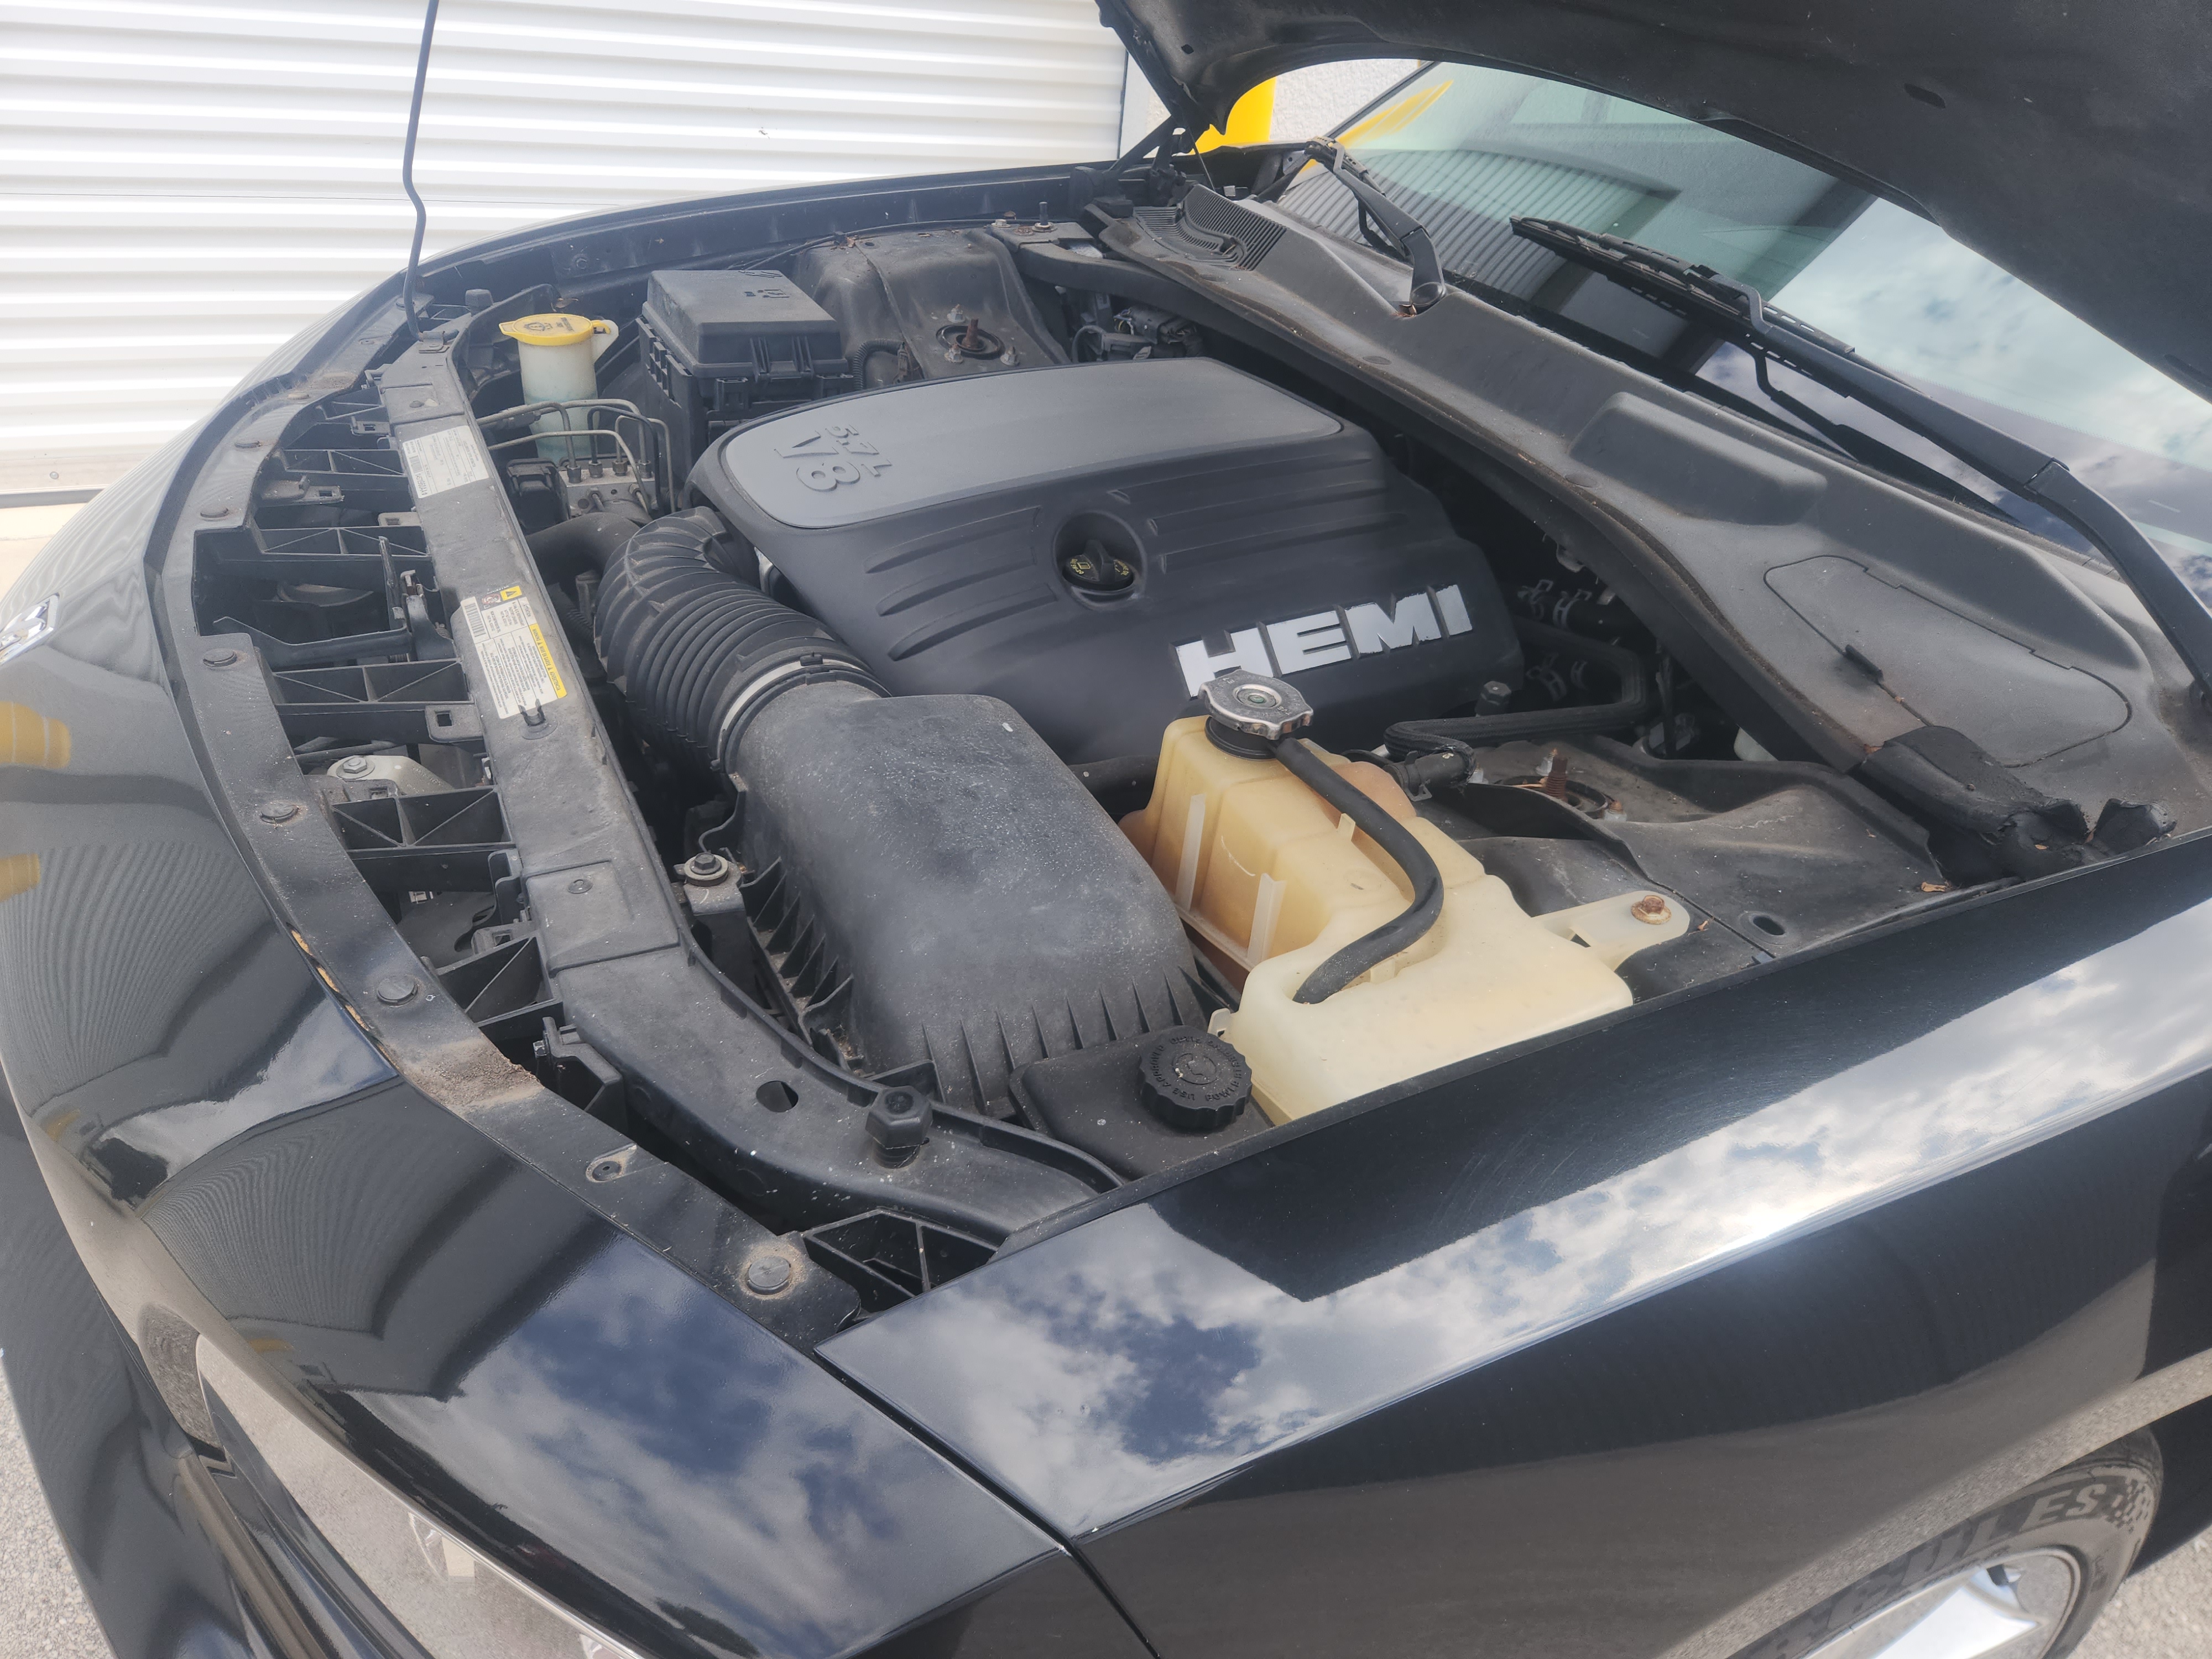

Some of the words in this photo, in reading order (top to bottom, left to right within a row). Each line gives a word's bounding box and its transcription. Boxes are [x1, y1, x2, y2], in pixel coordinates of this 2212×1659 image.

[774, 430, 860, 492] V8
[1171, 584, 1473, 701] HEMI
[1150, 1045, 1172, 1087] APPROVED
[1172, 1088, 1195, 1100] USE
[1205, 1079, 1240, 1101] POWER
